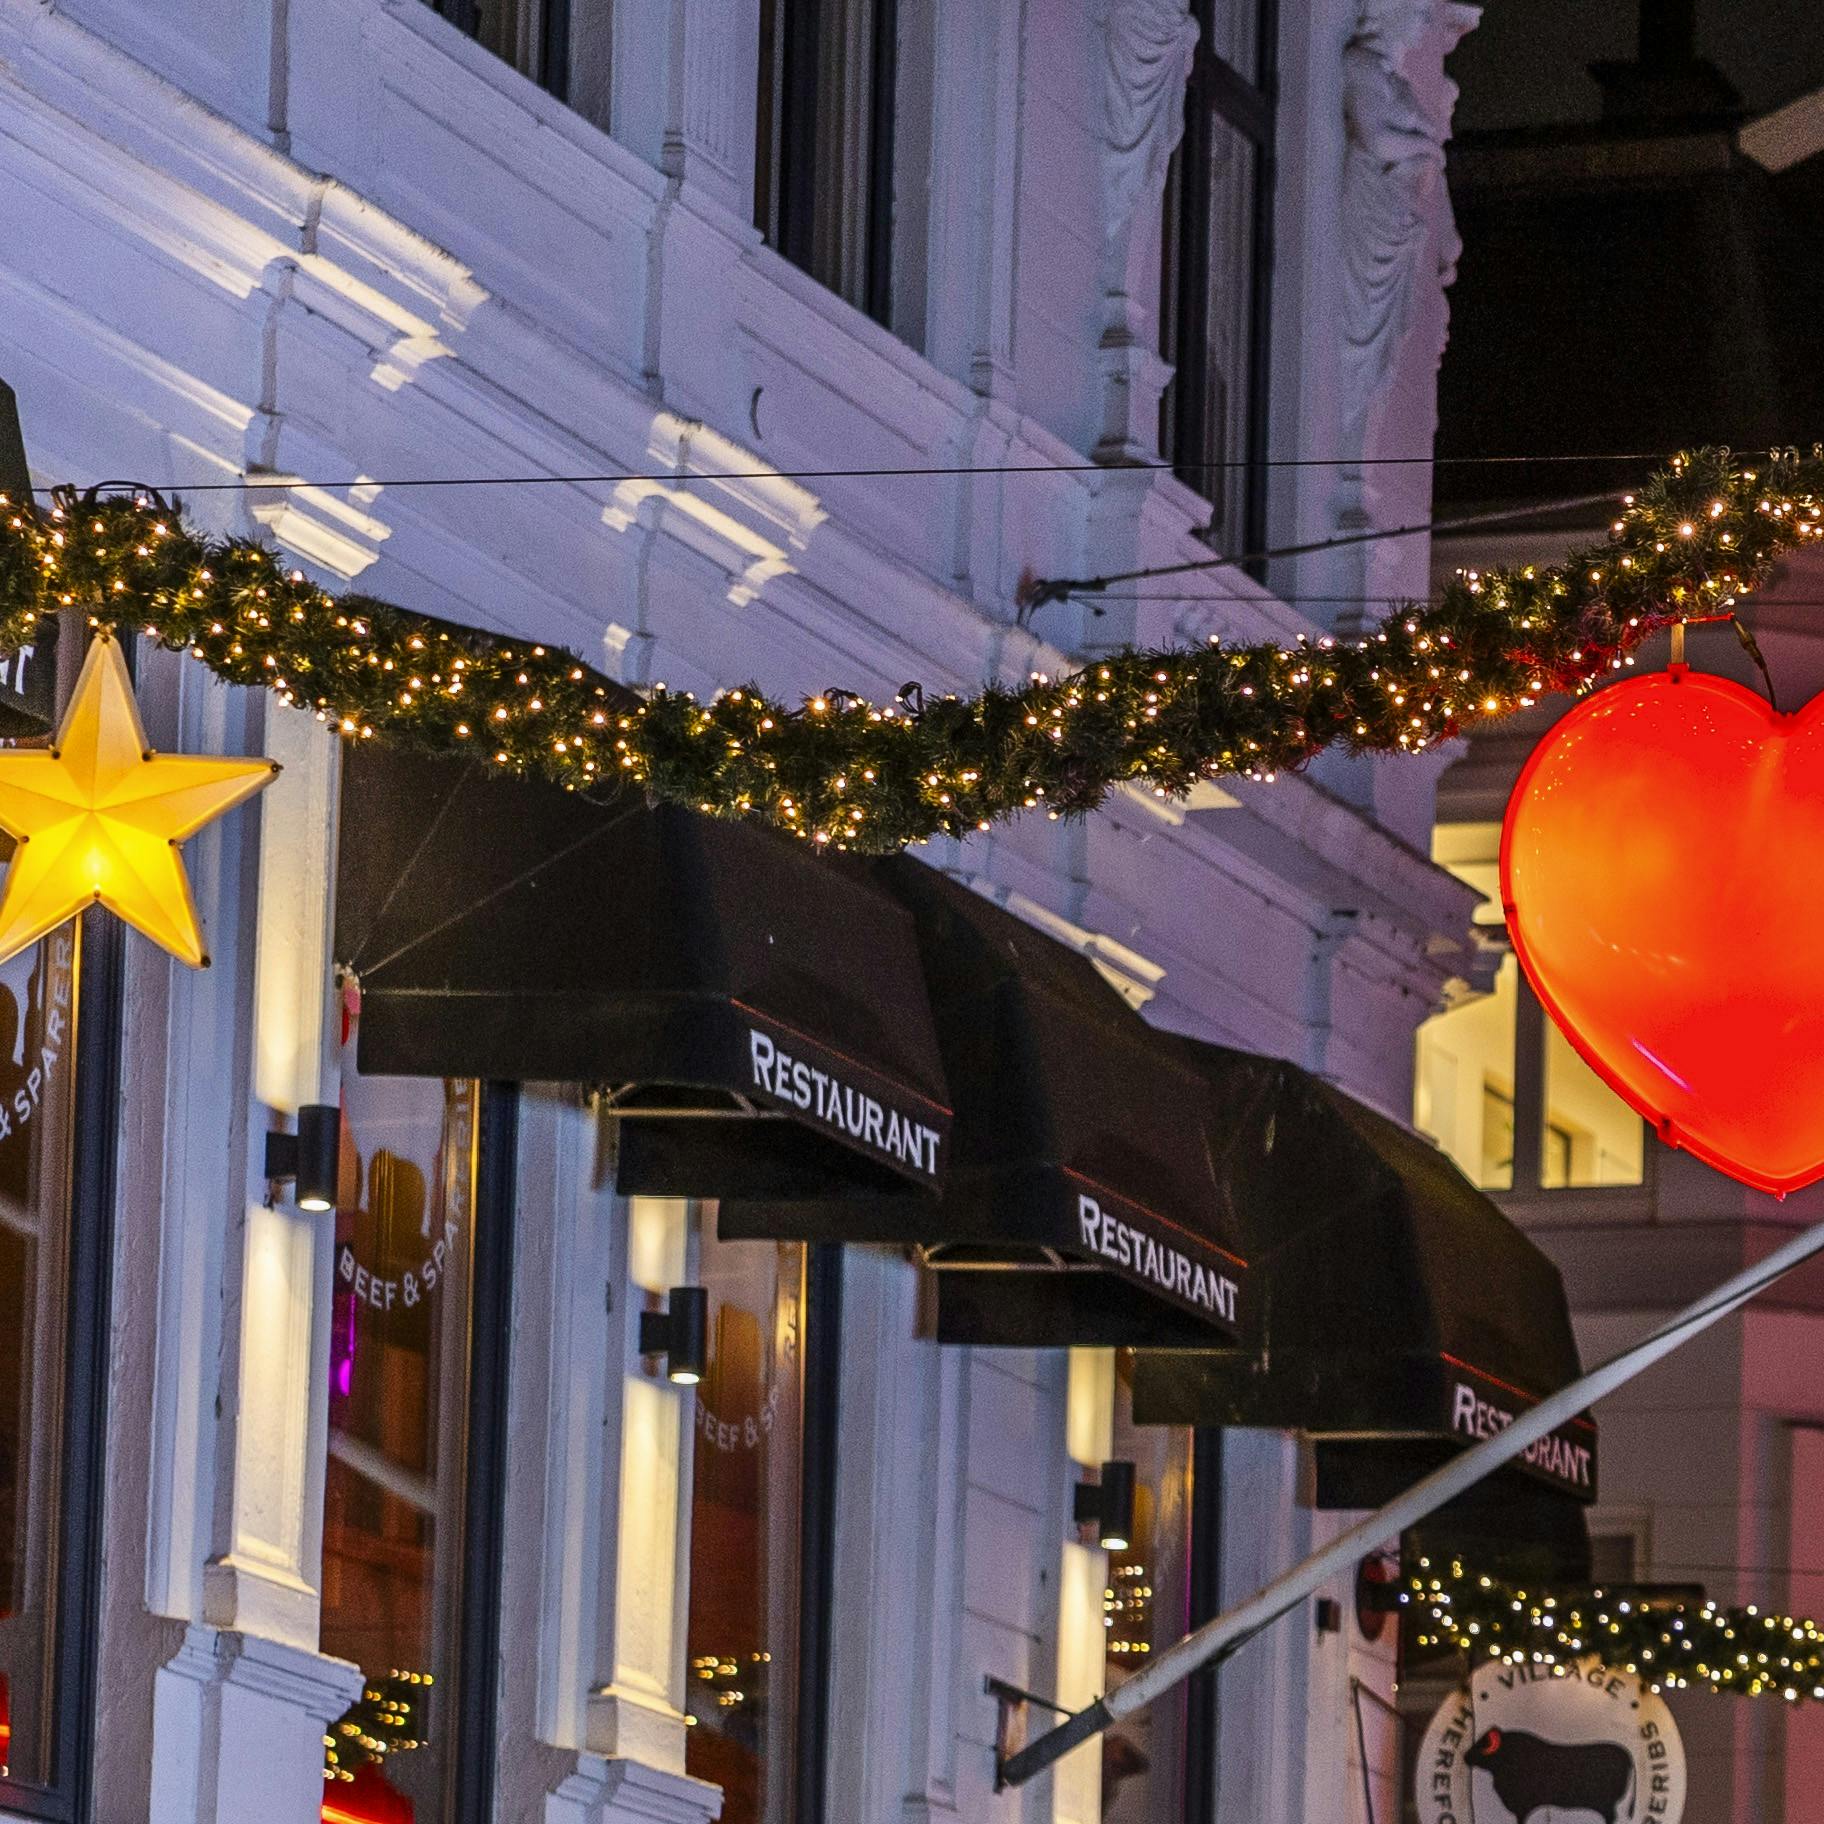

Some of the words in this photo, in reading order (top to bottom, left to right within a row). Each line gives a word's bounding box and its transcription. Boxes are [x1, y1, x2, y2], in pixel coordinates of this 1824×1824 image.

[748, 1029, 941, 1177] RESTAURANT
[339, 1245, 398, 1311] BEEF
[403, 1271, 421, 1307] &
[1078, 1194, 1241, 1322] RESTAURANT
[1452, 1382, 1591, 1487] RESTURANT
